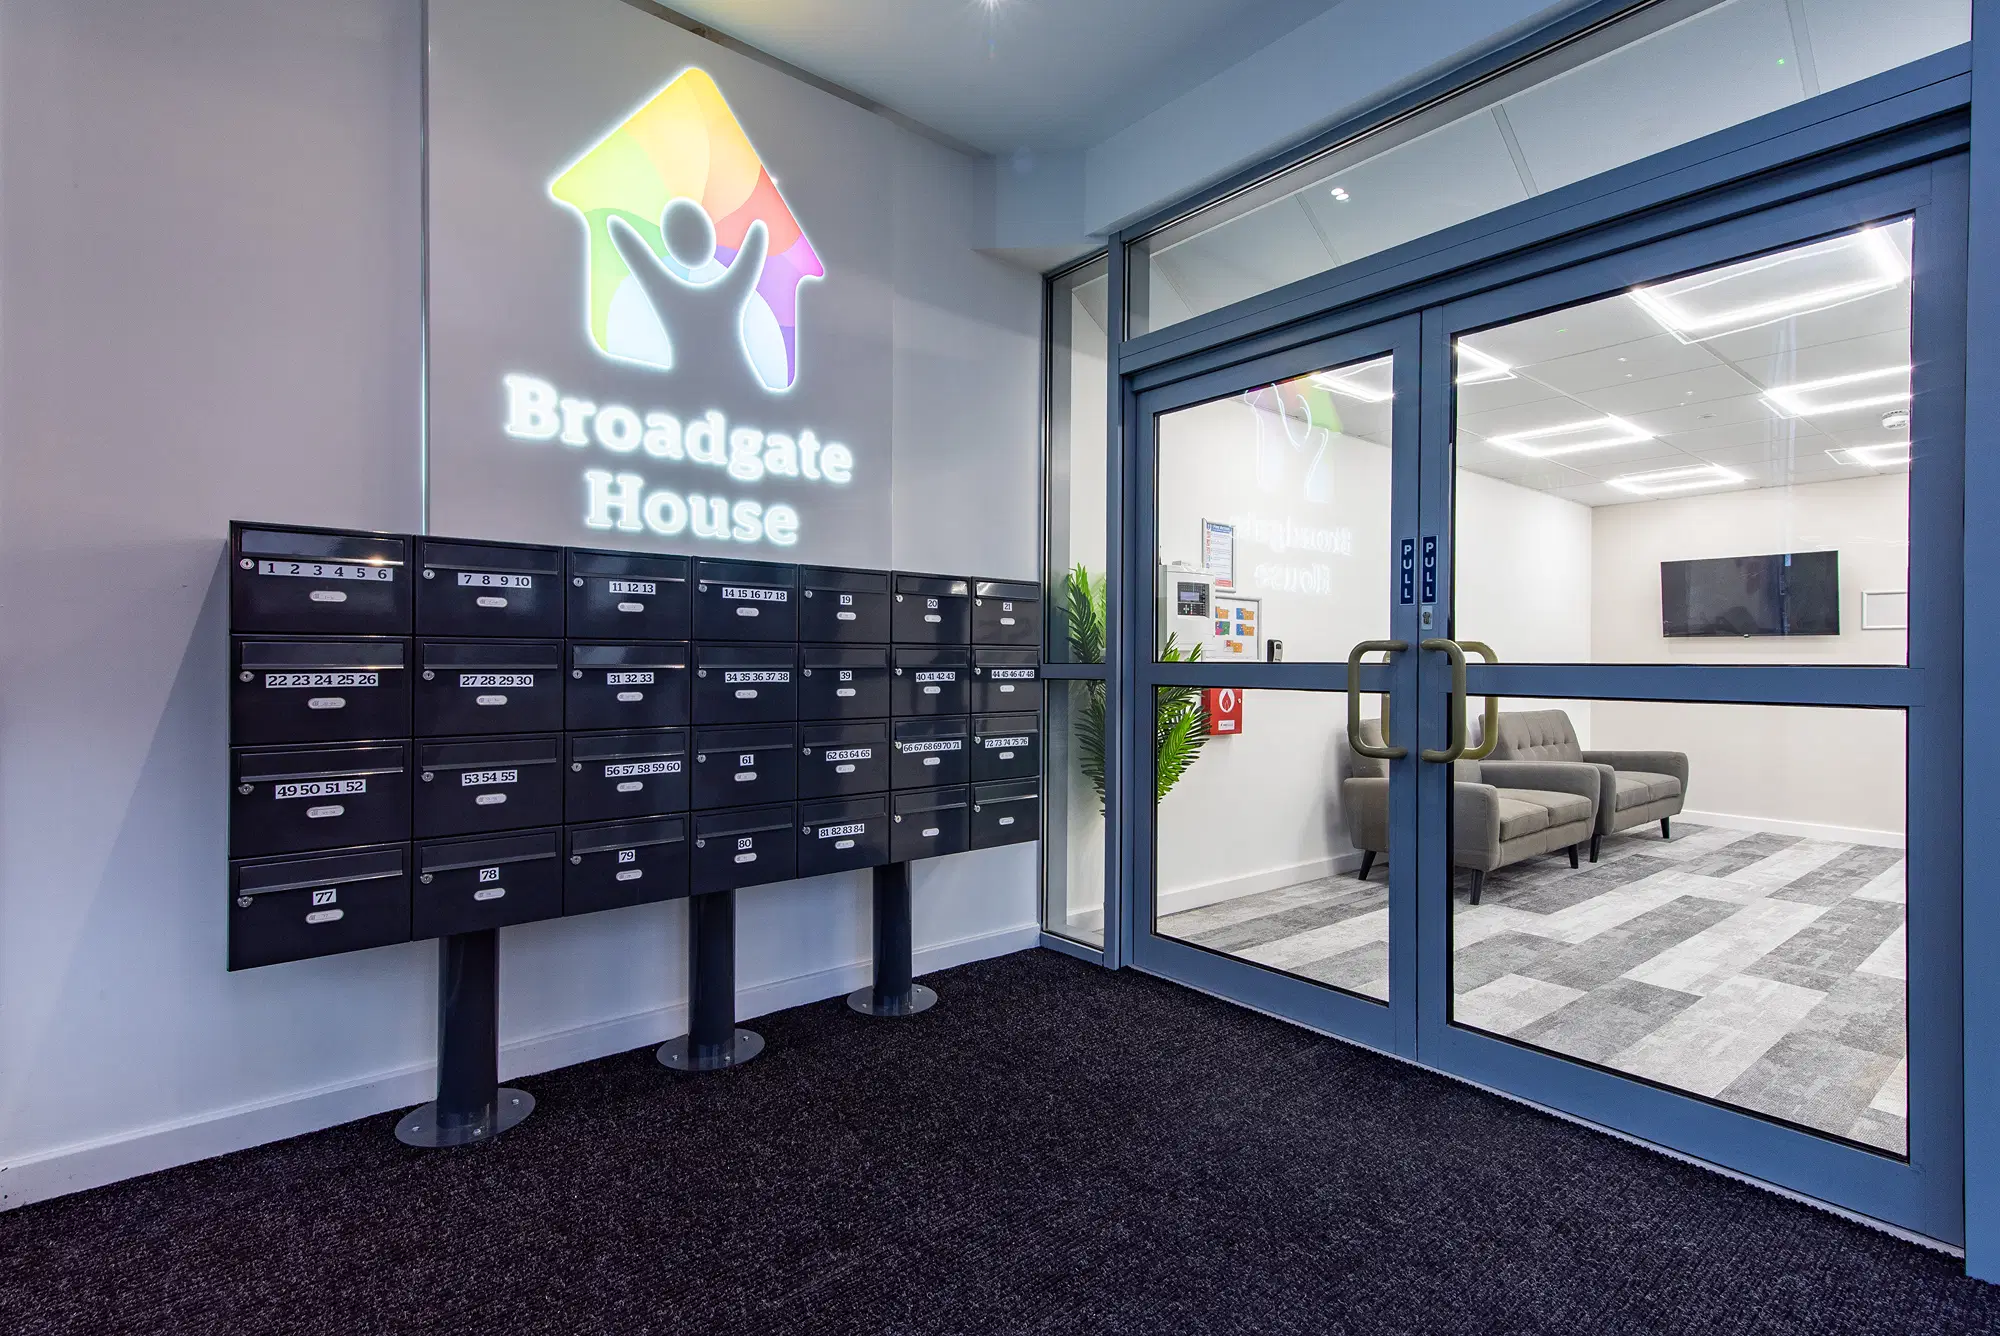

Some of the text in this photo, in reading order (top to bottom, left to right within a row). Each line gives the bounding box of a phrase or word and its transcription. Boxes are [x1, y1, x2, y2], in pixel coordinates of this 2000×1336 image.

[502, 372, 854, 484] Broadgate
[584, 469, 800, 545] House
[267, 562, 387, 580] 1 2 3 4 5 6
[1403, 544, 1413, 599] PULL
[1424, 541, 1435, 597] PULL
[464, 574, 530, 586] 7 8 9 10
[612, 582, 654, 593] 11 12 13
[724, 589, 786, 601] 14 15 16 17 18
[841, 596, 851, 604] 19
[927, 599, 938, 608] 20
[1004, 603, 1011, 611] 21
[267, 674, 377, 687] 22 23 24 25 26
[462, 676, 532, 686] 27 28 29 30
[610, 673, 653, 684] 31 32 33
[726, 672, 789, 682] 34 35 36 37 38
[840, 671, 851, 680] 39
[916, 673, 926, 681] 40
[936, 672, 945, 680] 42
[945, 672, 955, 680] 43
[903, 741, 960, 752] 66 67 68 69 70 71
[742, 755, 752, 765] 61
[827, 749, 870, 760] 62 63 64 65
[606, 762, 680, 776] 56 57 58 59 60
[464, 771, 516, 784] 53 54 55
[277, 780, 364, 797] 49 50 51 52
[820, 824, 863, 837] 81 82 83 84
[739, 838, 751, 849] 80
[620, 851, 634, 862] 79
[481, 869, 497, 881] 78
[315, 891, 334, 904] 77
